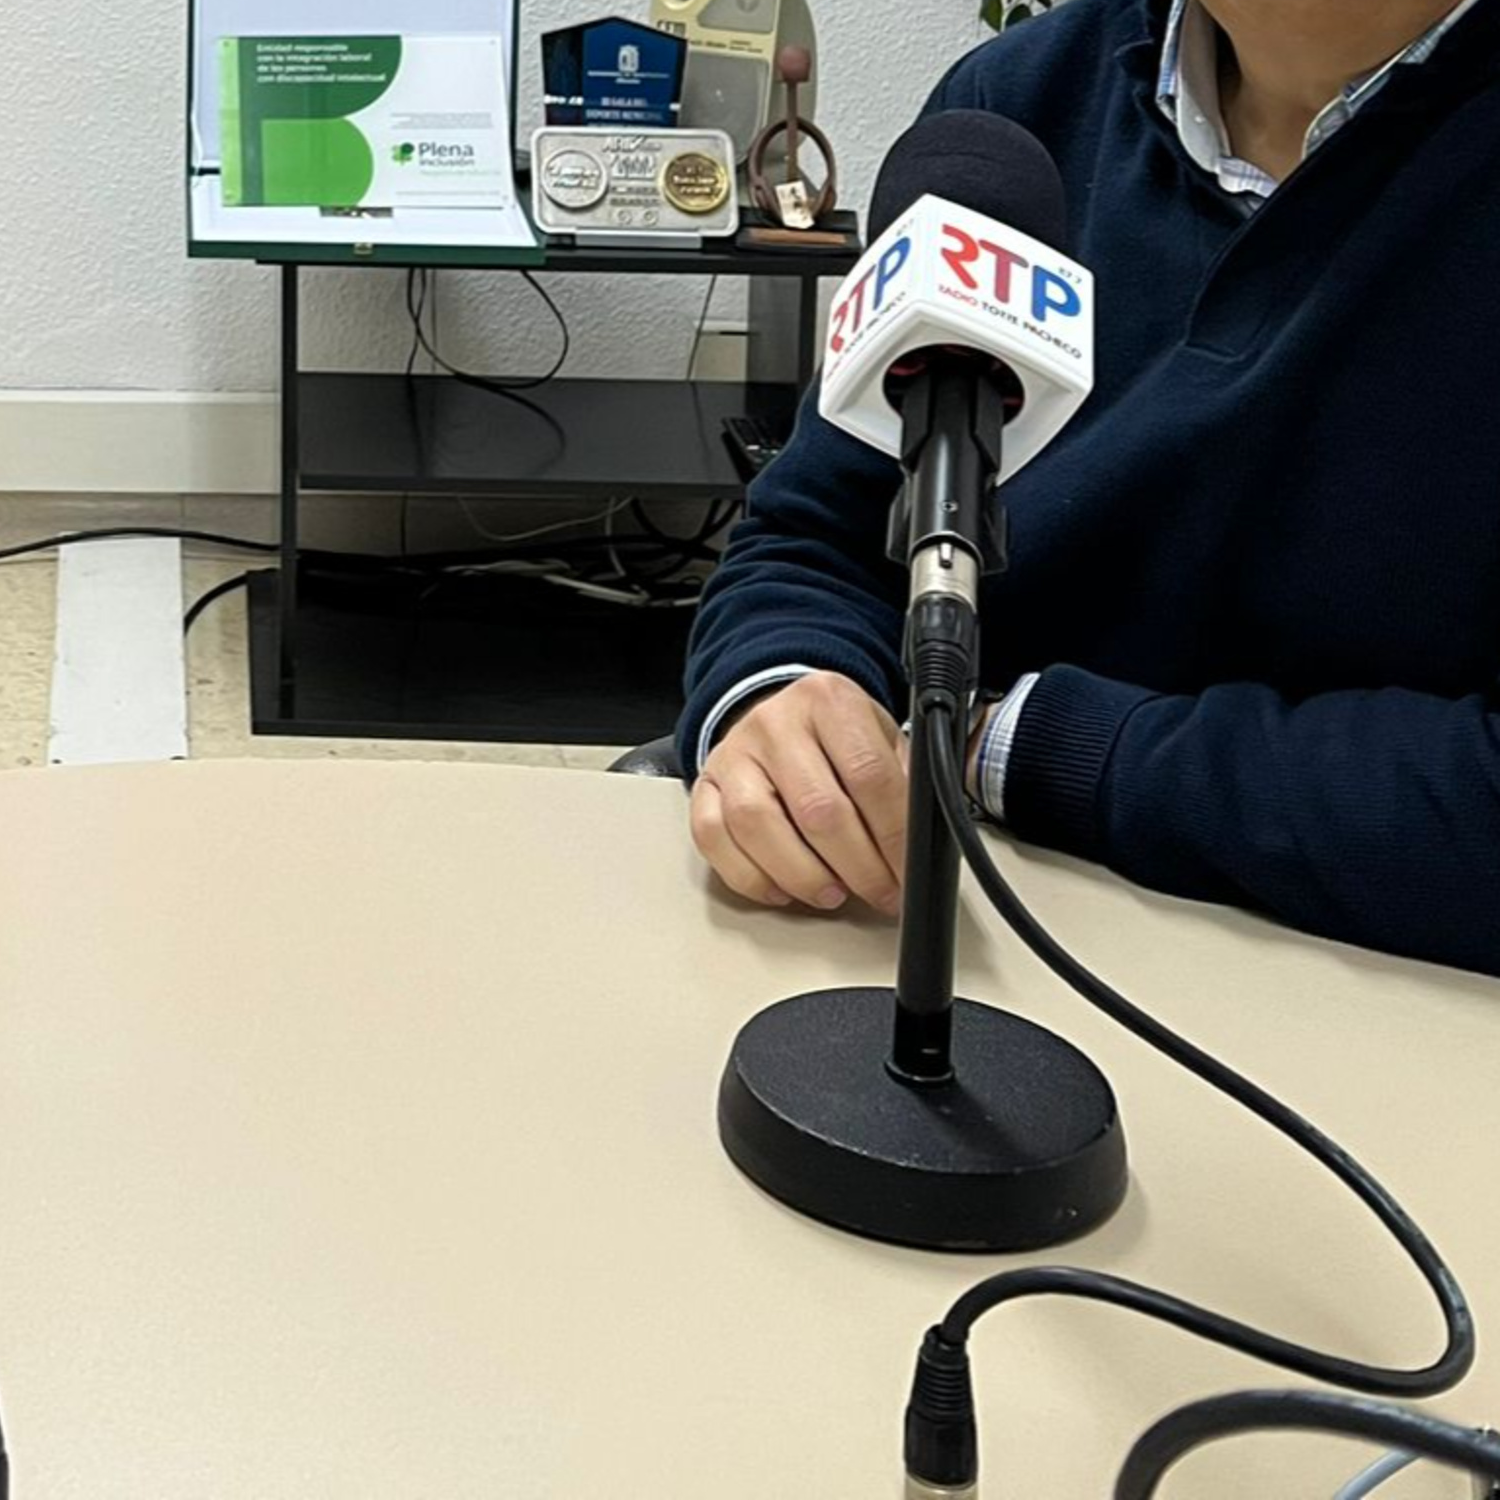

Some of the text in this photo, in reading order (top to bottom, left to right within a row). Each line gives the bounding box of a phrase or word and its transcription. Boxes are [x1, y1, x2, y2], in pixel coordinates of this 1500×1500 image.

[418, 141, 475, 157] Plena
[939, 223, 1082, 323] RTP
[937, 284, 1083, 360] RADIO TORRE PACHECO
